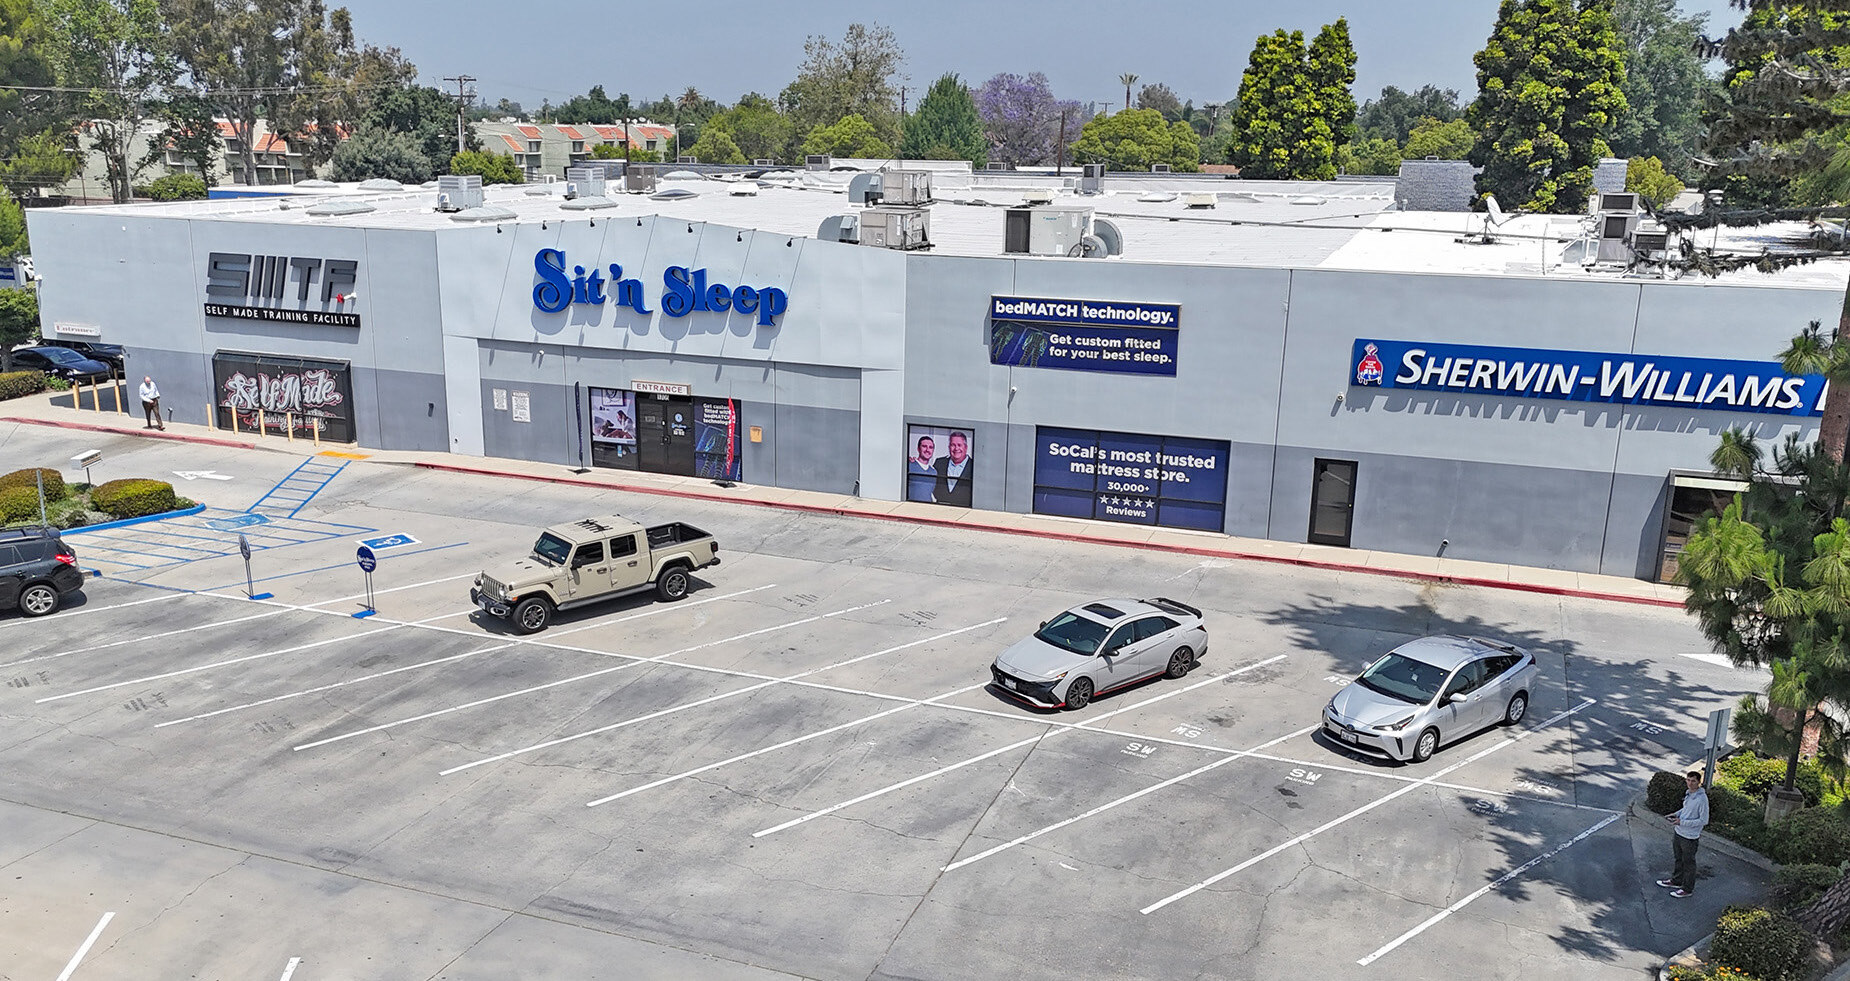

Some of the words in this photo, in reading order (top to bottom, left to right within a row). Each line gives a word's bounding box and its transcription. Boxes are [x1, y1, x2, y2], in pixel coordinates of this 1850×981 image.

[533, 248, 653, 314] Sit'n
[661, 265, 789, 326] Sleep
[206, 305, 228, 316] SELF
[232, 308, 259, 318] MADE
[263, 310, 308, 322] TRAINING
[313, 314, 356, 326] FACILITY
[995, 301, 1078, 318] bedMATCH
[1082, 306, 1174, 324] technology.
[1050, 334, 1072, 345] Get
[1074, 338, 1121, 349] custom
[1124, 338, 1161, 350] fitted
[1050, 346, 1068, 358] for
[1070, 350, 1100, 360] your
[1102, 349, 1131, 361] best
[1133, 352, 1173, 365] sleep.
[636, 383, 683, 394] ENTRANCE
[1049, 442, 1107, 460] SoCal's
[1110, 449, 1151, 464] most
[1155, 452, 1216, 469] trusted
[1070, 461, 1140, 478] mattress
[1143, 467, 1190, 483] store.
[1107, 481, 1150, 493] 30,000+
[1106, 505, 1147, 518] Reviews
[1126, 742, 1157, 755] SW
[1290, 768, 1322, 781] SW
